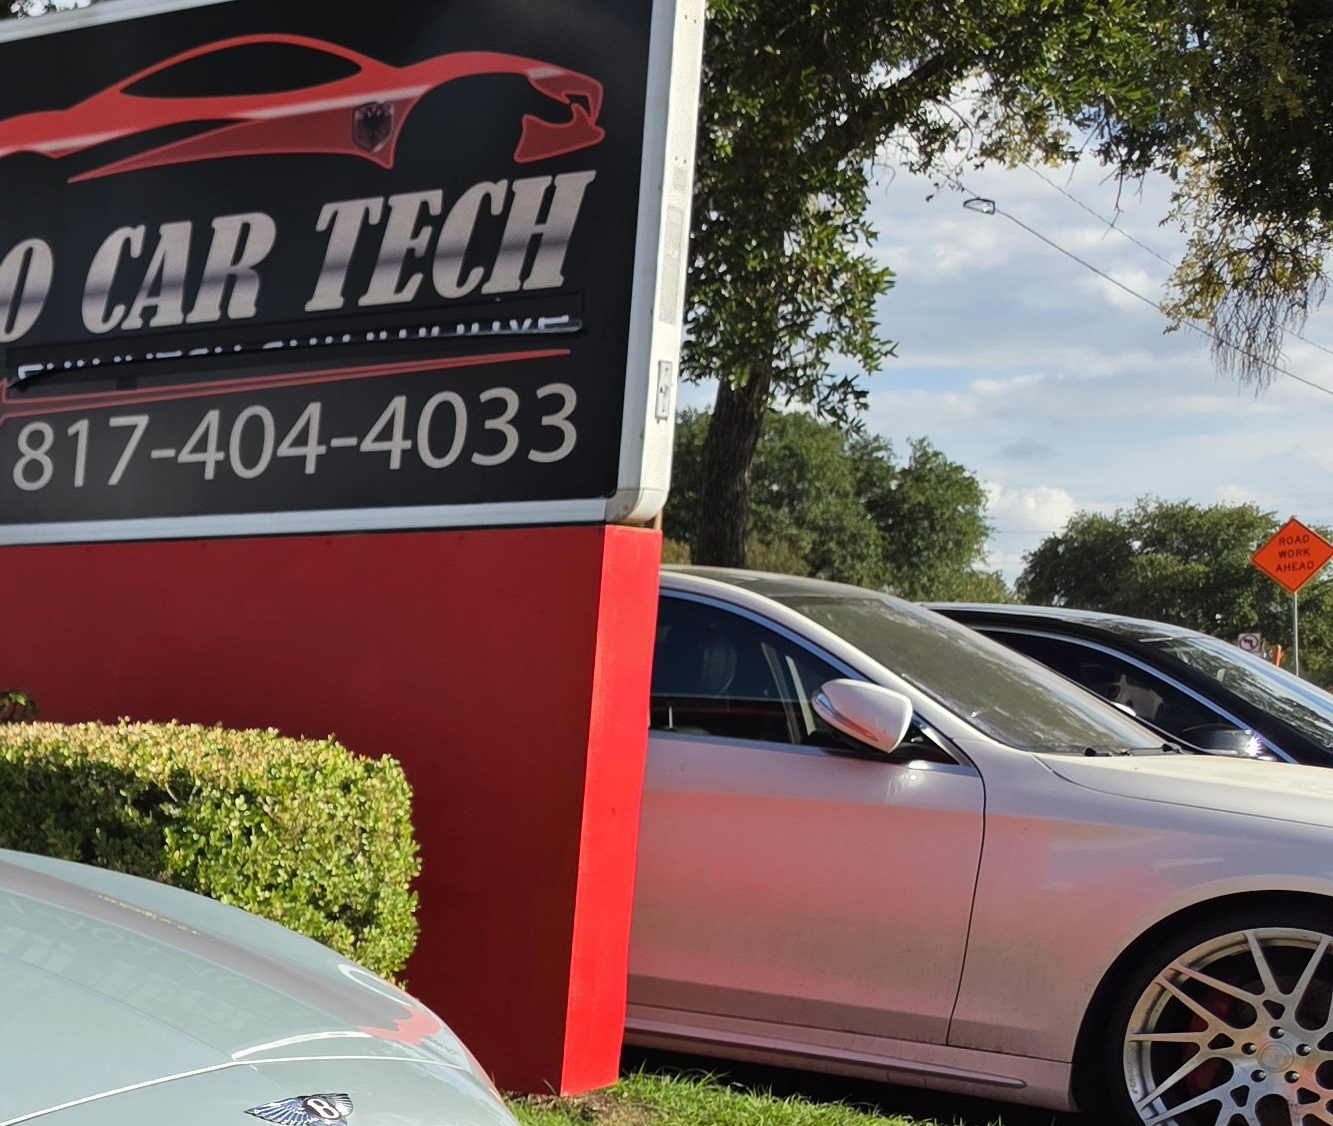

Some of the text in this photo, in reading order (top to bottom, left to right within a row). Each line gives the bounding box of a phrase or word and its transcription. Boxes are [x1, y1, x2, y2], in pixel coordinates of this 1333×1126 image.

[81, 211, 277, 334] CAR
[304, 169, 597, 312] TECH
[11, 382, 579, 492] 817-404-4033
[1278, 534, 1310, 546] ROAD
[1278, 547, 1311, 559] WORK
[1275, 561, 1315, 573] AHEAD
[306, 1097, 340, 1120] B
